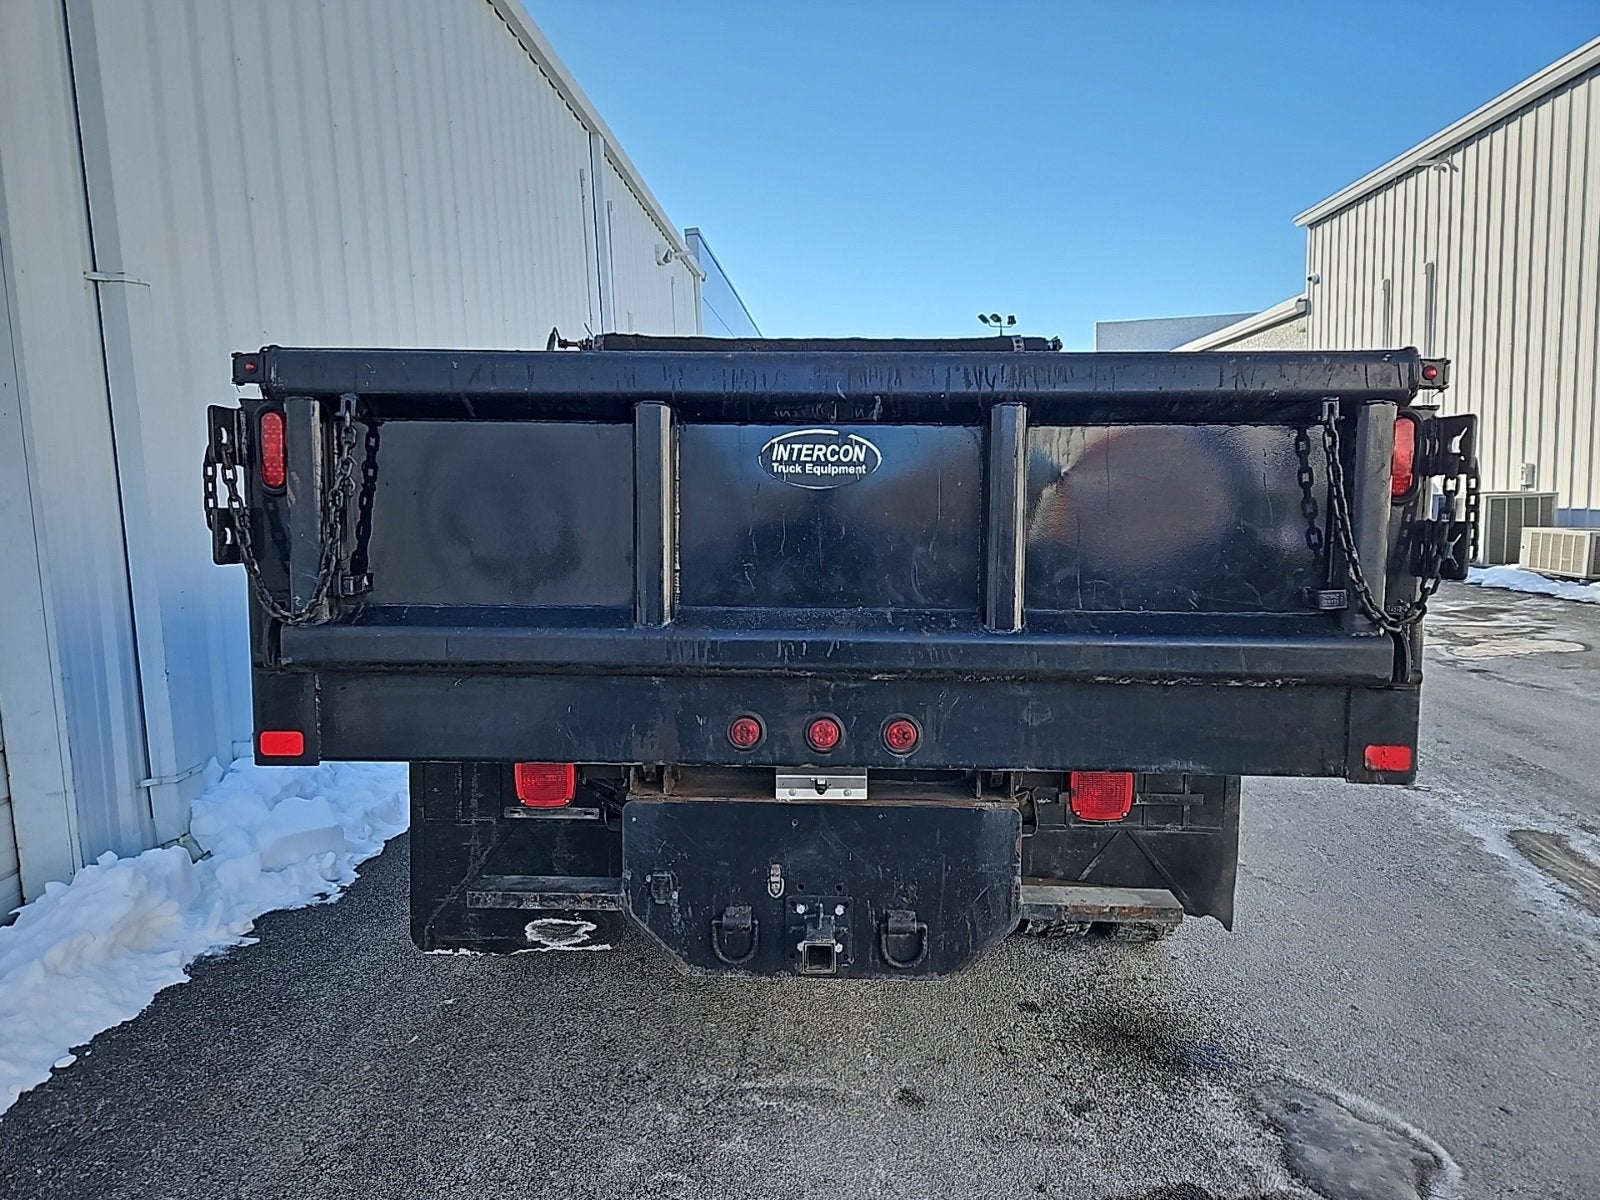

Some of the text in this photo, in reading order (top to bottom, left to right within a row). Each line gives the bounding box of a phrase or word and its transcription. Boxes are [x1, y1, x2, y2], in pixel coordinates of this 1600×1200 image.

[772, 444, 867, 462] INTERCON
[772, 463, 866, 476] Truck Equipment
